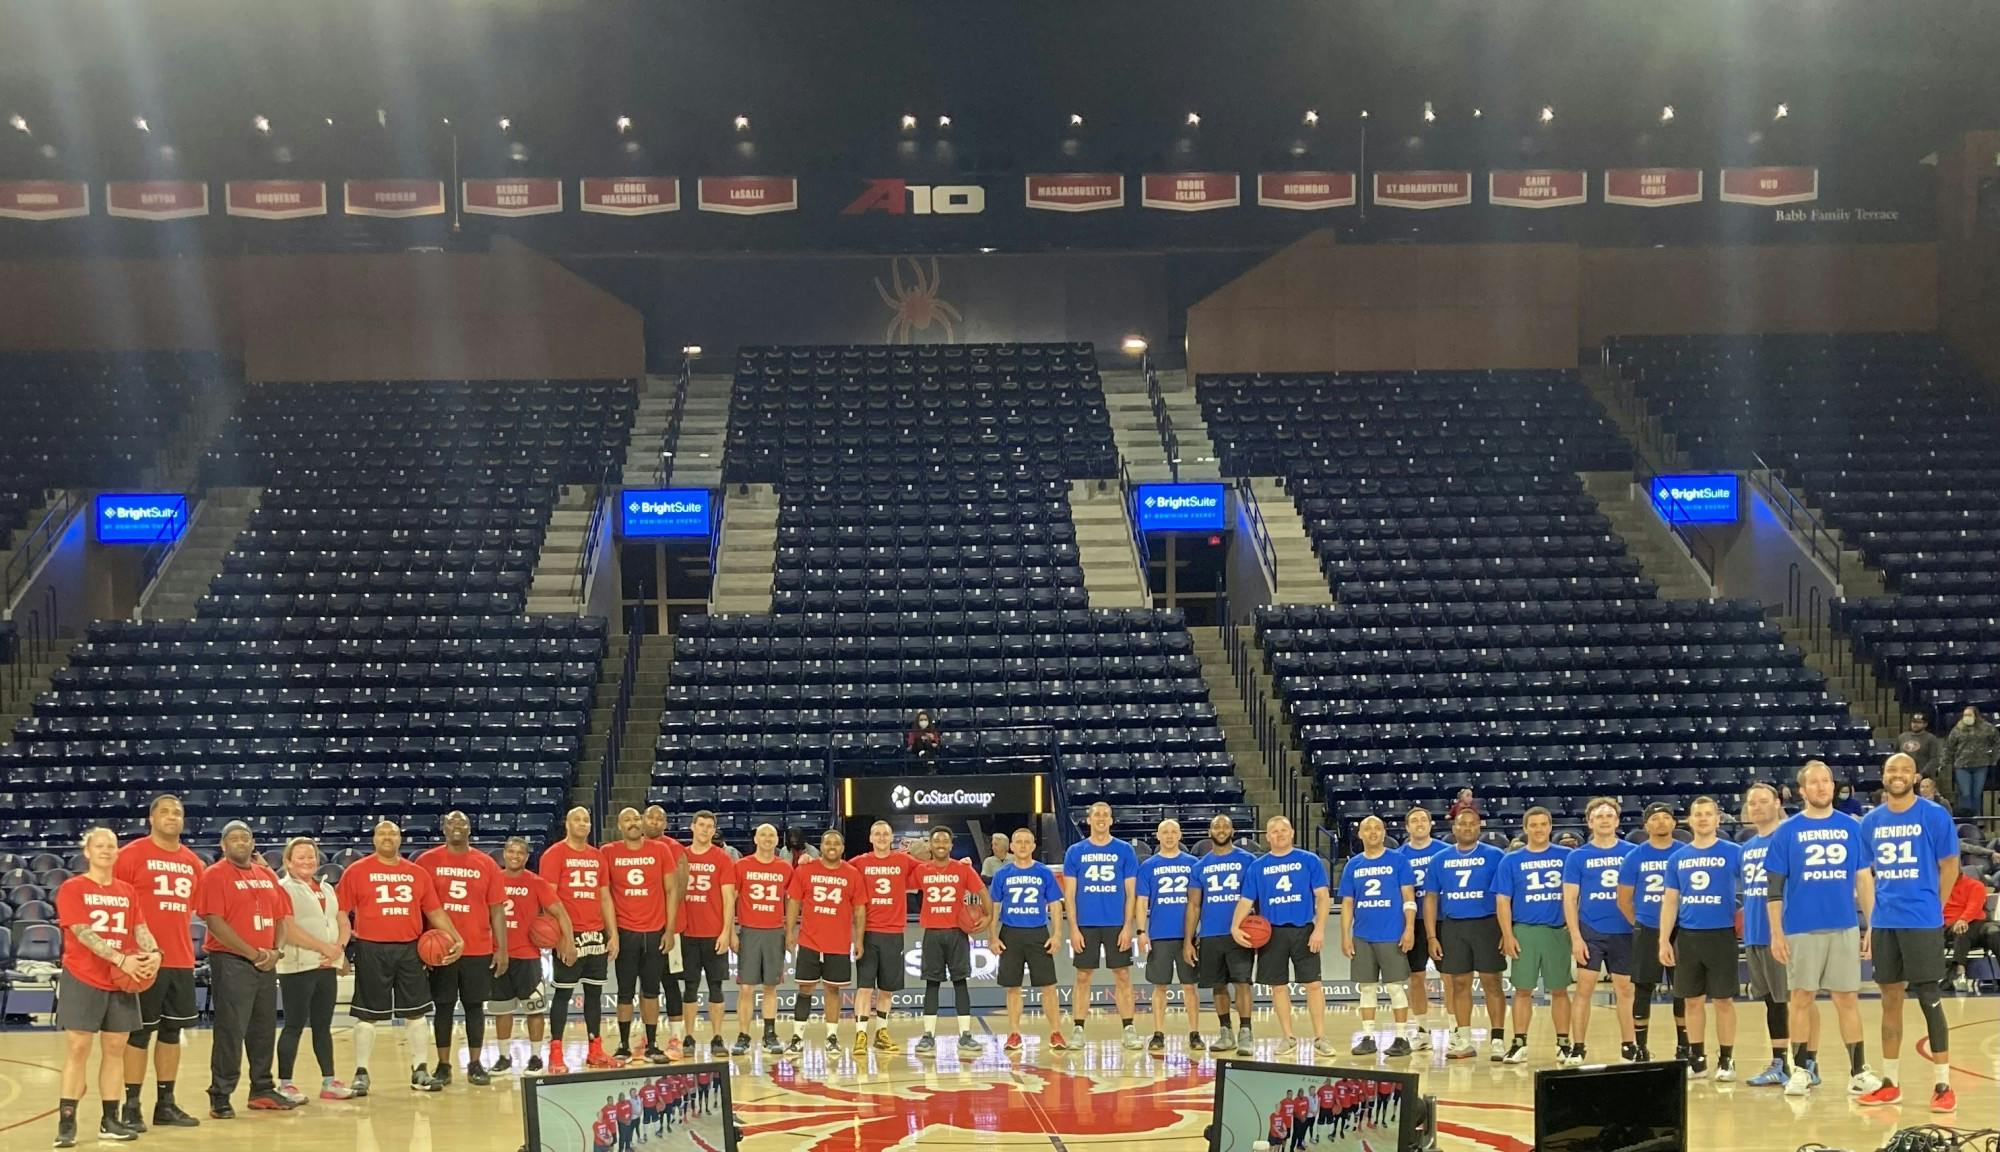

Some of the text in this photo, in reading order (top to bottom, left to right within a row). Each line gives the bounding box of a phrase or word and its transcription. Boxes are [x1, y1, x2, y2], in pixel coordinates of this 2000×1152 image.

[1525, 176, 1550, 186] SAINT
[1640, 174, 1666, 185] SAINT
[1038, 185, 1112, 198] MASSACHUSETTS
[1175, 190, 1207, 201] ISLAND
[1284, 184, 1330, 195] RICHMOND
[1519, 186, 1557, 197] JOSEPH'S
[1640, 185, 1666, 196] LOUIS
[497, 196, 529, 205] MASON
[602, 194, 659, 204] WASHINGTON
[1812, 208, 1852, 223] Family
[1855, 208, 1899, 221] Terrace
[1671, 488, 1730, 501] BrightSuite
[641, 501, 702, 515] BrightSuite
[1157, 496, 1216, 510] BrightSuite
[1798, 829, 1848, 843] HENRICO
[1874, 824, 1922, 839] HENRICO
[1081, 853, 1119, 863] HENRICO
[1805, 843, 1848, 866] 29
[1877, 841, 1918, 865] 31
[147, 860, 194, 875] HENRICO
[566, 858, 600, 868] HENRICO
[615, 857, 656, 867] HENRICO
[1203, 862, 1242, 874] HENRICO
[1443, 857, 1485, 869] HENRICO
[1520, 859, 1563, 871] HENRICO
[1586, 856, 1623, 869] HENRIC
[1678, 857, 1726, 870] HENRICO
[436, 867, 481, 879] HENRICO
[864, 866, 901, 876] HENRICO
[1084, 865, 1116, 881] 45
[1153, 865, 1191, 875] HENRICO
[1263, 862, 1302, 875] HENRICO
[1354, 866, 1393, 878] HENRICO
[1743, 862, 1768, 883] 32
[1876, 869, 1919, 879] POLICE
[369, 873, 414, 883] HENRICO
[568, 870, 598, 888] 15
[626, 868, 645, 886] 6
[746, 871, 783, 883] HENRICO
[810, 875, 848, 887] HENRICO
[923, 874, 959, 884] HENRICO
[1006, 876, 1042, 886] HENRICO
[1455, 869, 1472, 888] 7
[1526, 871, 1561, 890] 13
[1600, 869, 1618, 888] 8
[1690, 870, 1710, 891] 9
[1803, 870, 1847, 881] POLICE
[153, 874, 193, 898] 18
[875, 878, 891, 894] 3
[1158, 876, 1188, 894] 22
[1207, 873, 1240, 891] 14
[1275, 875, 1292, 892] 4
[1364, 879, 1381, 897] 2
[375, 884, 413, 903] 13
[448, 880, 468, 899] 5
[573, 891, 595, 899] FIRE
[625, 888, 649, 897] FIRE
[748, 884, 780, 902] 31
[926, 886, 957, 903] 32
[1084, 885, 1117, 893] POLICE
[1447, 890, 1484, 900] POLICE
[84, 894, 130, 908] HENRICO
[685, 895, 707, 903] FIRE
[812, 886, 842, 905] 54
[871, 897, 893, 906] FIRE
[1008, 887, 1039, 904] 72
[1207, 894, 1241, 904] POLICE
[1268, 894, 1302, 905] POLICE
[1682, 896, 1722, 905] POLICE
[160, 901, 188, 912] FIRE
[444, 903, 471, 913] FIRE
[752, 904, 775, 913] FIRE
[930, 905, 953, 914] FIRE
[1357, 899, 1391, 908] POLICE
[382, 907, 410, 916] FIRE
[814, 905, 837, 916] FIRE
[1007, 906, 1040, 914] POLICE
[89, 909, 129, 935] 21
[1253, 983, 1274, 996] Th
[1288, 982, 1351, 997] Yeman
